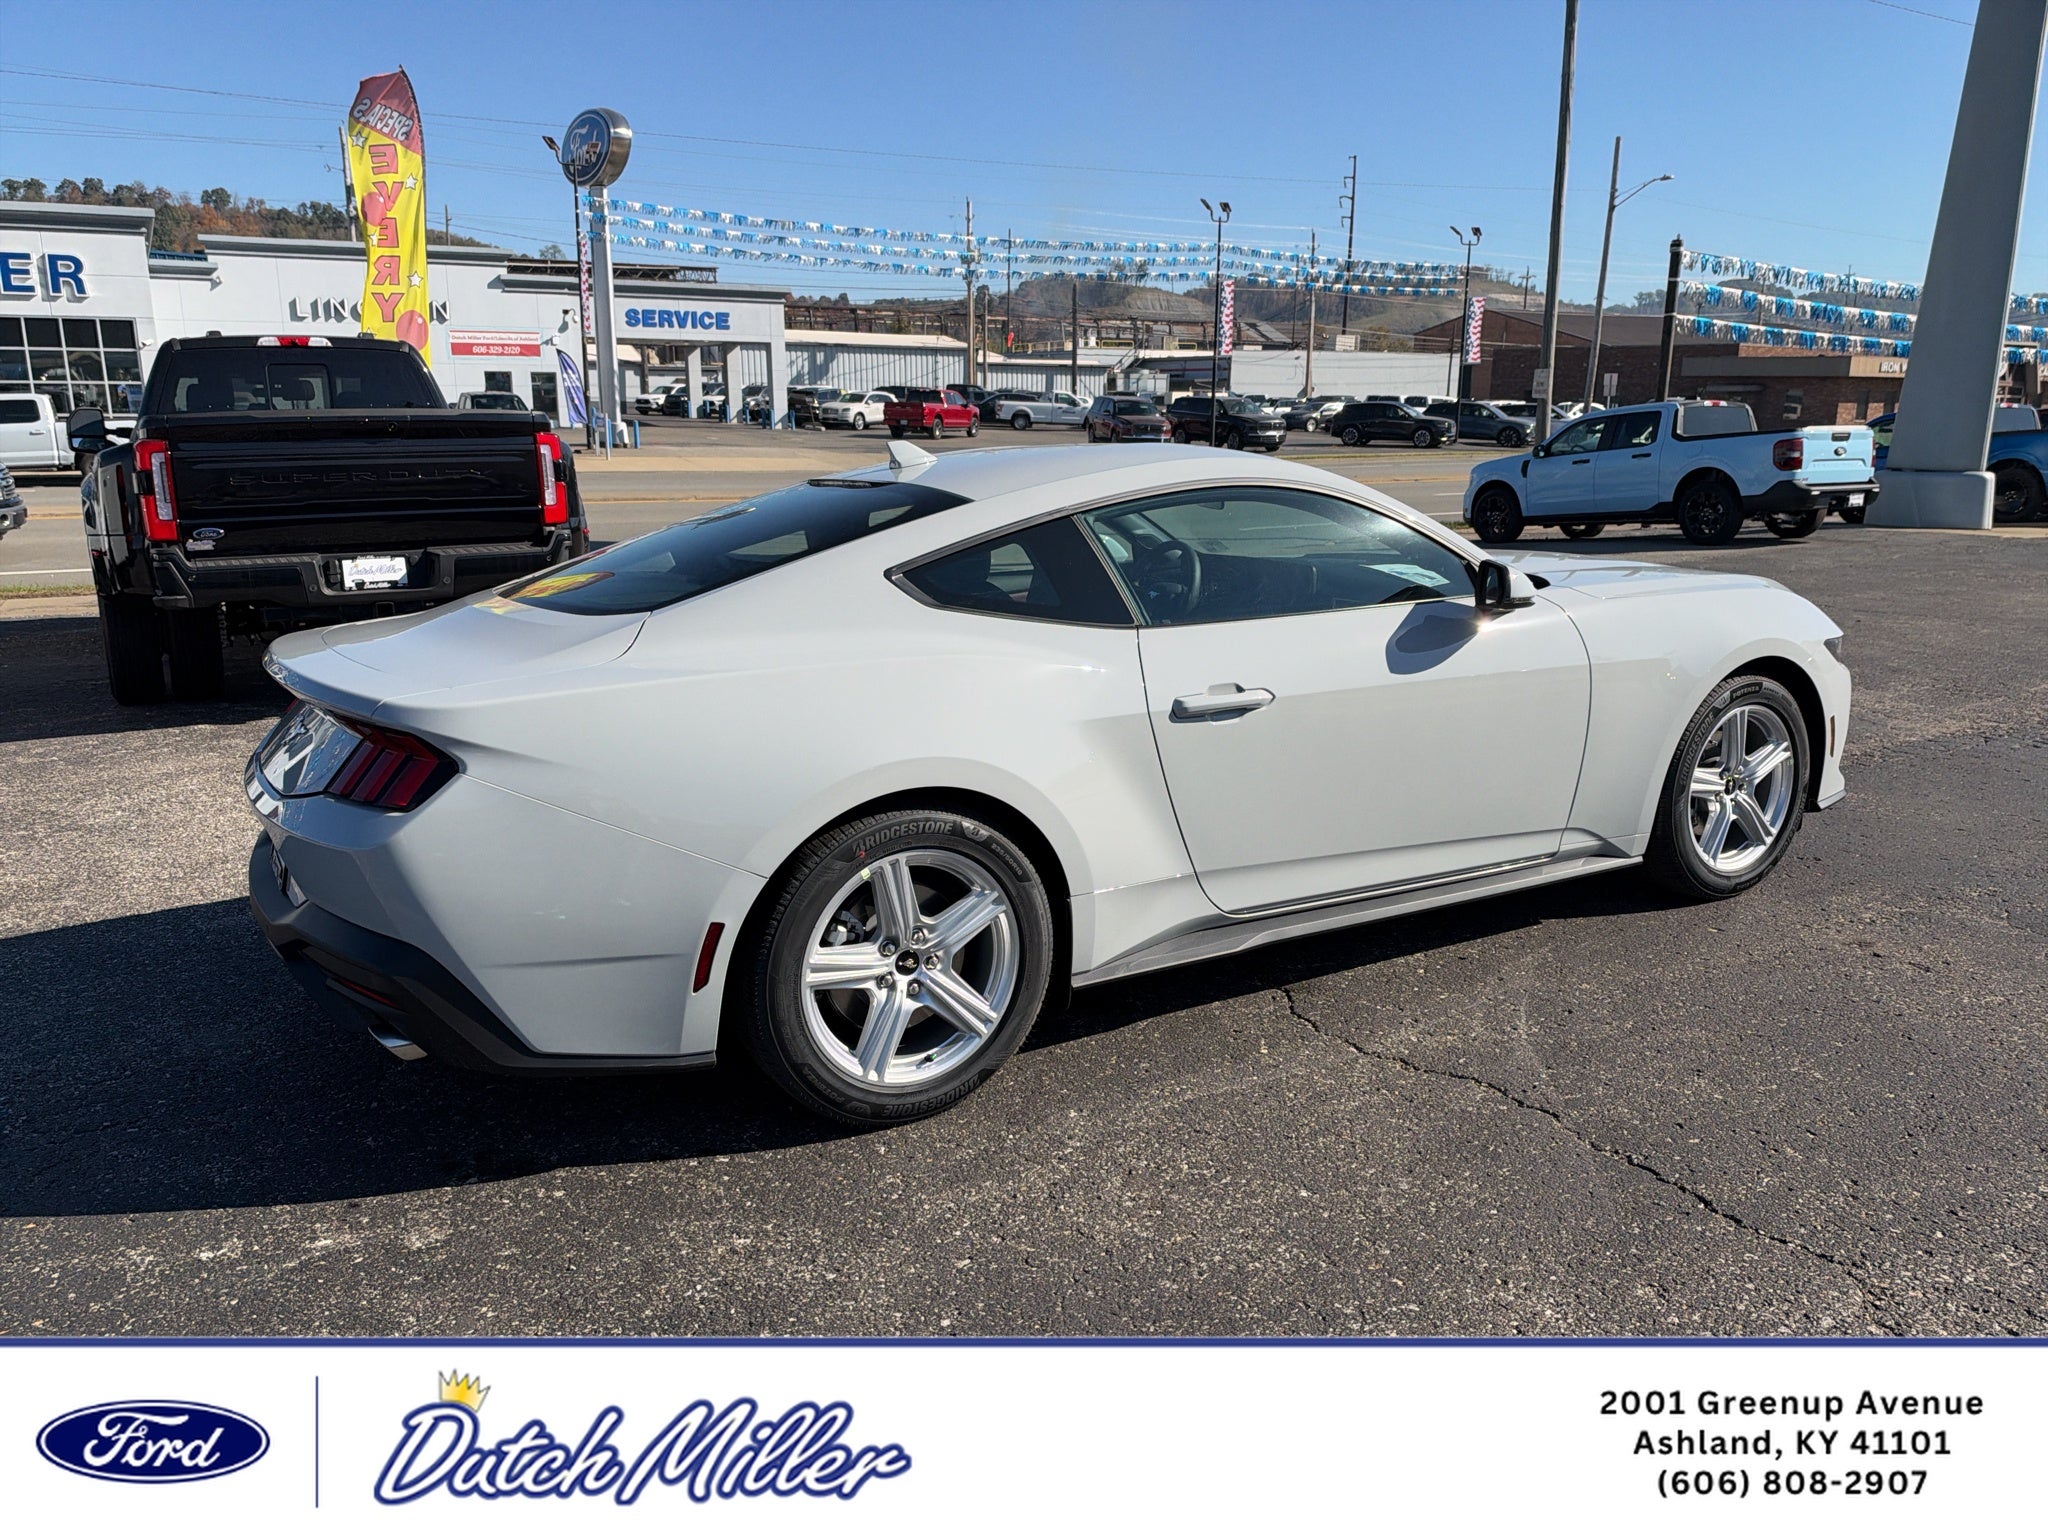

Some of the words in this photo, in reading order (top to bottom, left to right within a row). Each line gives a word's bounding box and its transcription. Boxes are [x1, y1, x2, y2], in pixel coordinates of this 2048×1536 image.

[290, 296, 450, 324] LINN
[625, 308, 731, 331] SERVICE
[852, 821, 954, 858] BRIDGESTONE
